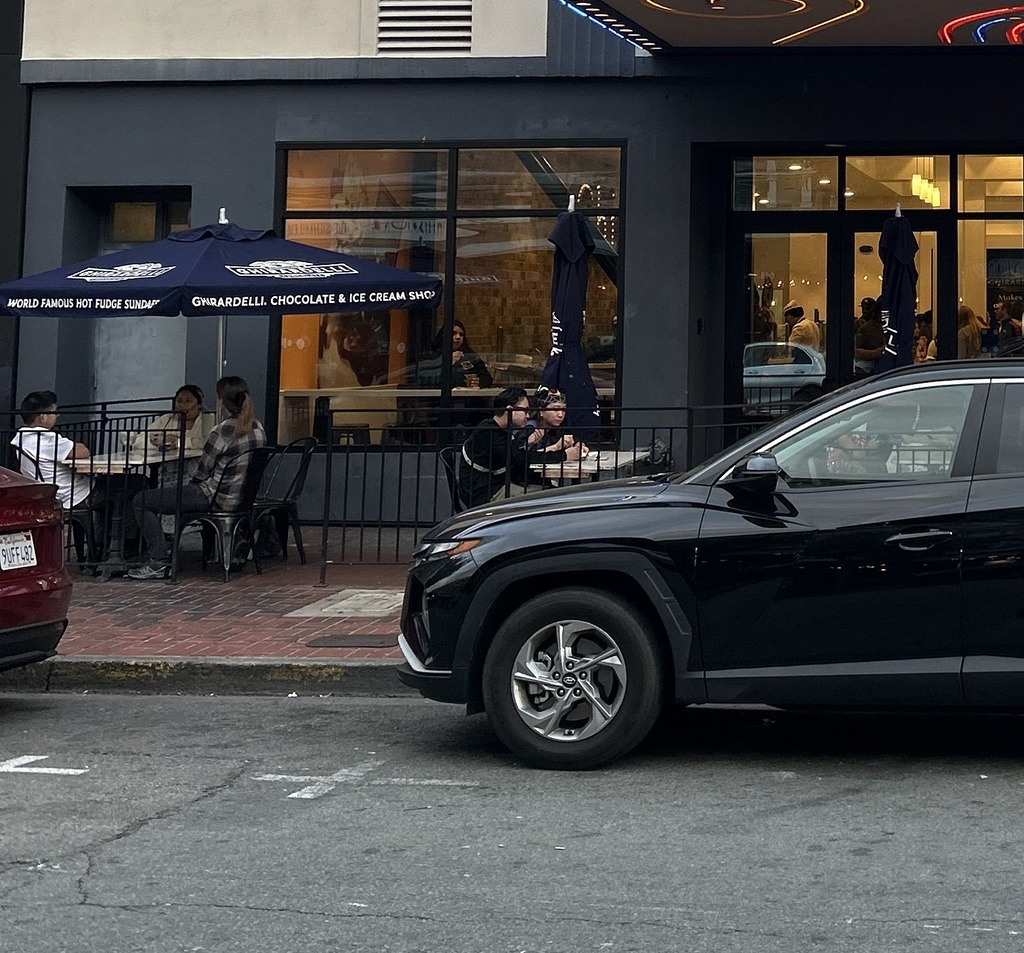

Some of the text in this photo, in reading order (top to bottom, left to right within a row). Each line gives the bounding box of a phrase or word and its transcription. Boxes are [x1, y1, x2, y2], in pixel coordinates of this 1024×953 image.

[7, 299, 39, 309] WORLD
[41, 299, 74, 309] FAMOUS
[76, 299, 93, 309] HOT
[95, 299, 122, 309] FUDGE
[271, 294, 335, 305] CHOCOLATE
[338, 293, 346, 303] &
[349, 293, 366, 303] ICE
[369, 291, 406, 302] CREAM
